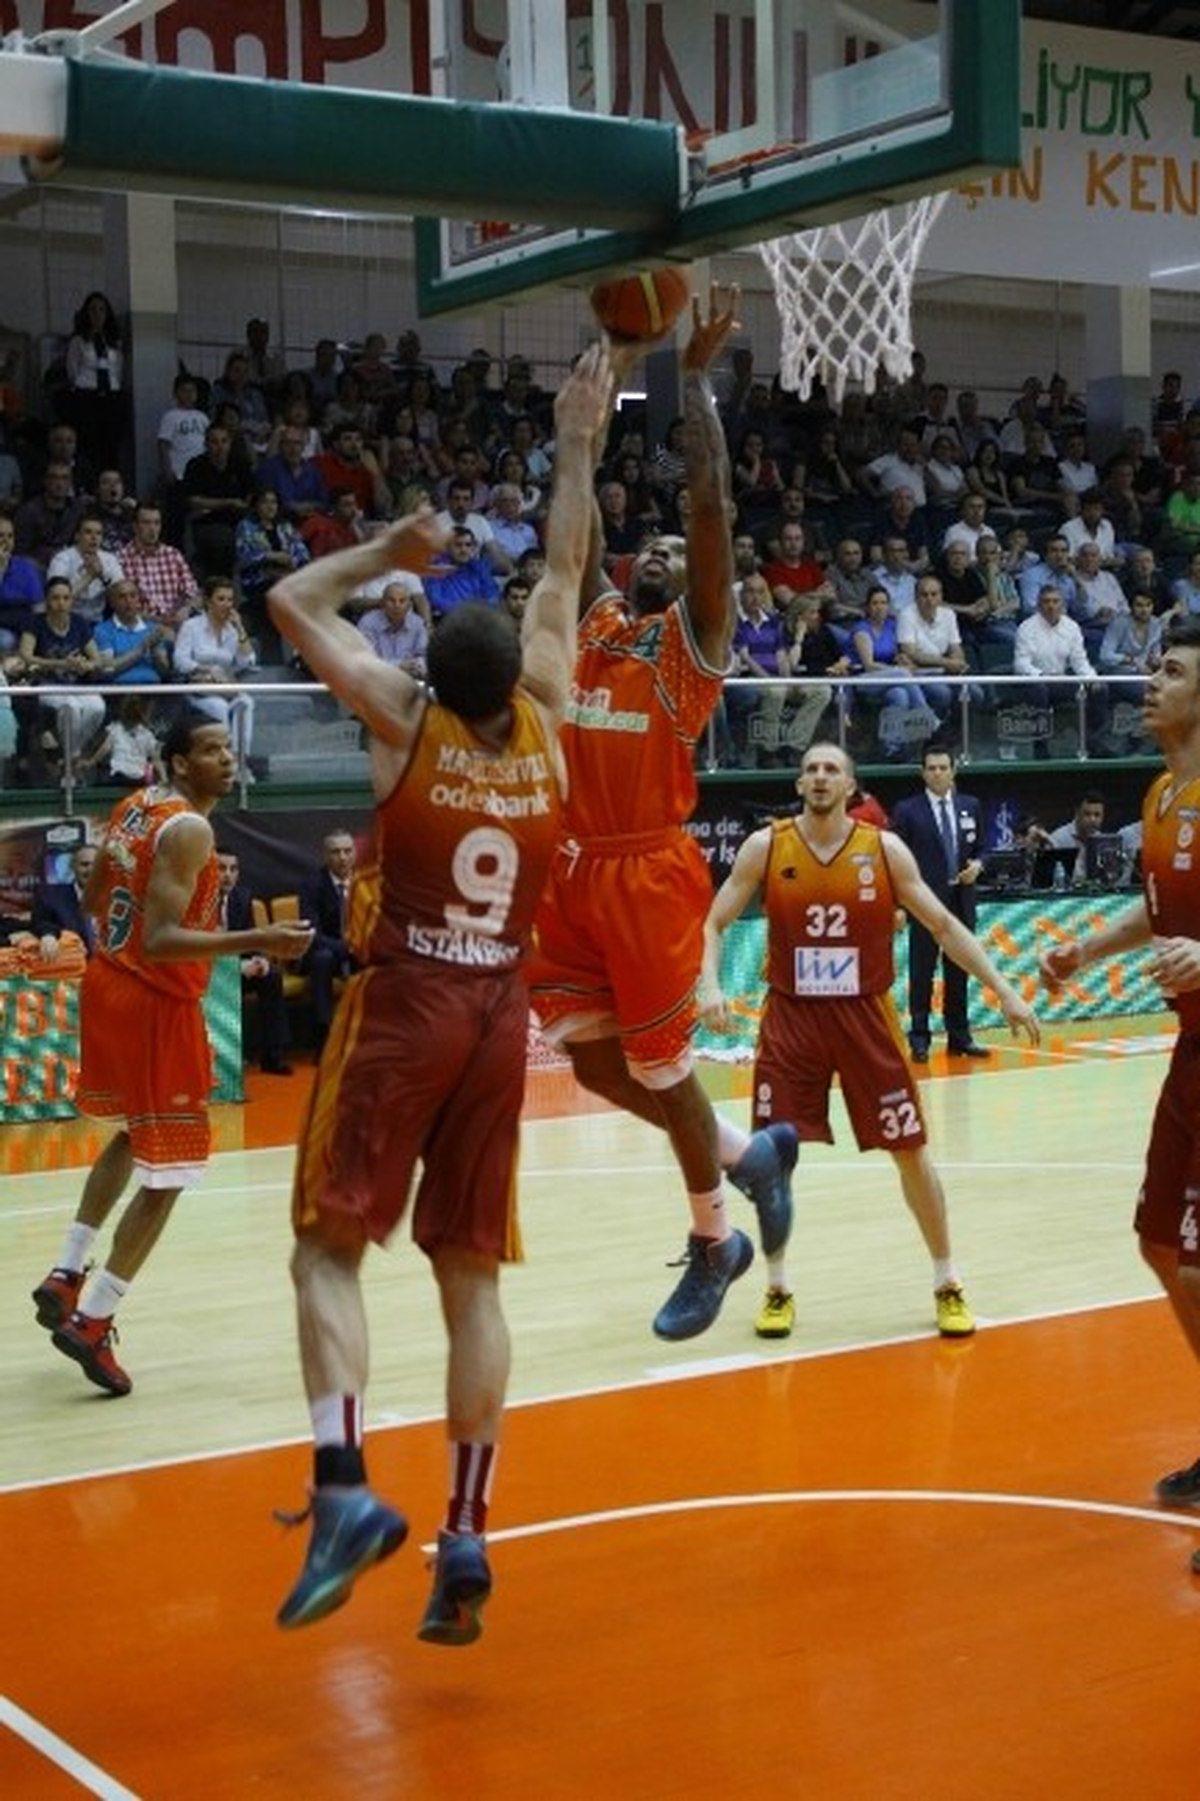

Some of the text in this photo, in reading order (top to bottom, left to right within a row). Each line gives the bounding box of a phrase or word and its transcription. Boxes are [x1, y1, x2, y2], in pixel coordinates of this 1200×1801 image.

[443, 826, 519, 935] 9
[108, 886, 135, 952] 9
[805, 903, 847, 938] 32
[878, 1101, 922, 1141] 32
